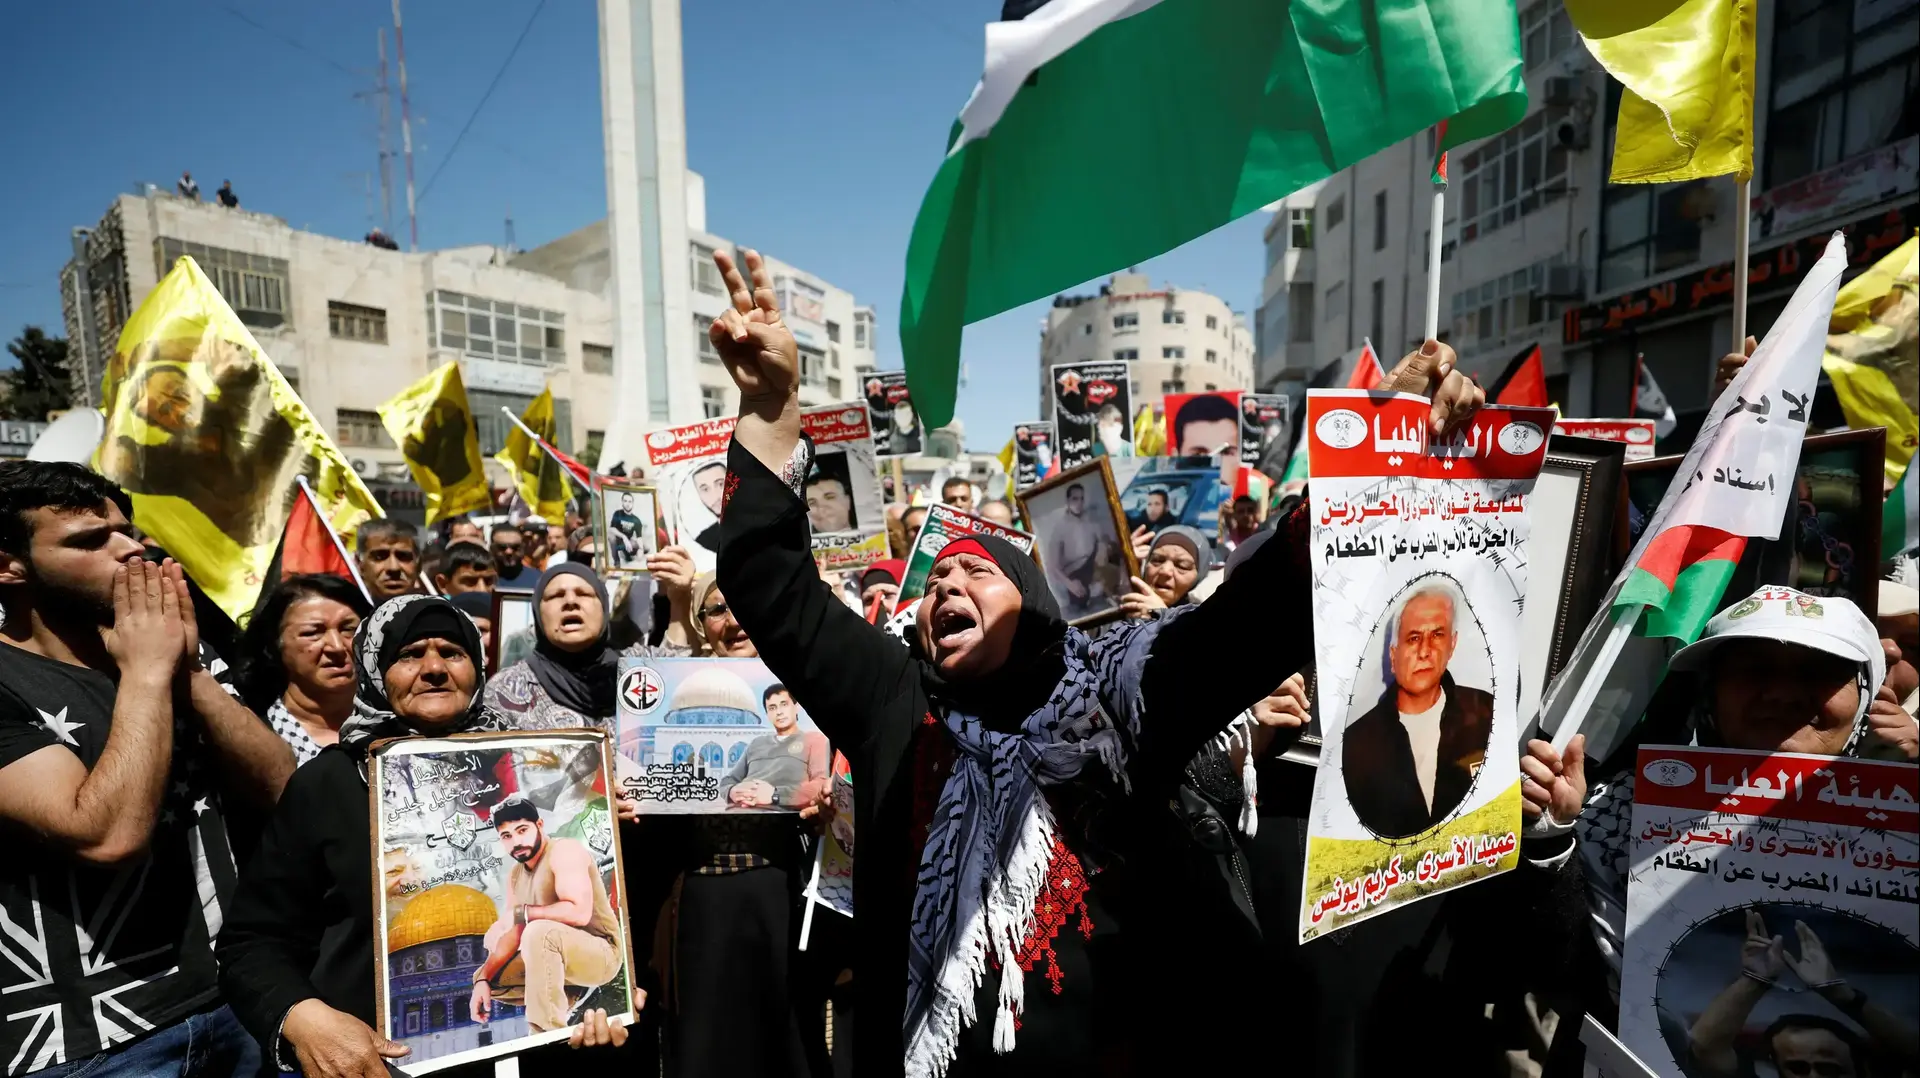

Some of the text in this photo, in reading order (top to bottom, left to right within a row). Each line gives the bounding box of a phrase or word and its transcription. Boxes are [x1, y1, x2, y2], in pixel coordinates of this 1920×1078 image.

[1782, 389, 1809, 422] لا
[675, 426, 704, 444] العليا
[1373, 413, 1427, 467] العليا
[1321, 494, 1410, 527] والمحررين
[1441, 491, 1470, 522] شؤون
[1473, 492, 1524, 520] لمتابعة
[1325, 523, 1515, 565] الحرية للأسير المضرب عن الطعام
[1762, 592, 1791, 601] 12
[411, 764, 444, 789] البطل
[1704, 764, 1803, 807] العليا
[428, 788, 461, 812] خليل
[461, 780, 501, 807] مصباح
[1477, 832, 1517, 867] عميد
[1641, 820, 1756, 854] والمحررين
[1759, 834, 1847, 860] الأسرى
[1418, 835, 1474, 884] الأسرى
[1653, 852, 1719, 876] الطعام
[1723, 861, 1756, 884] عن
[1761, 869, 1839, 894] المضرب
[1311, 876, 1360, 923] يونس
